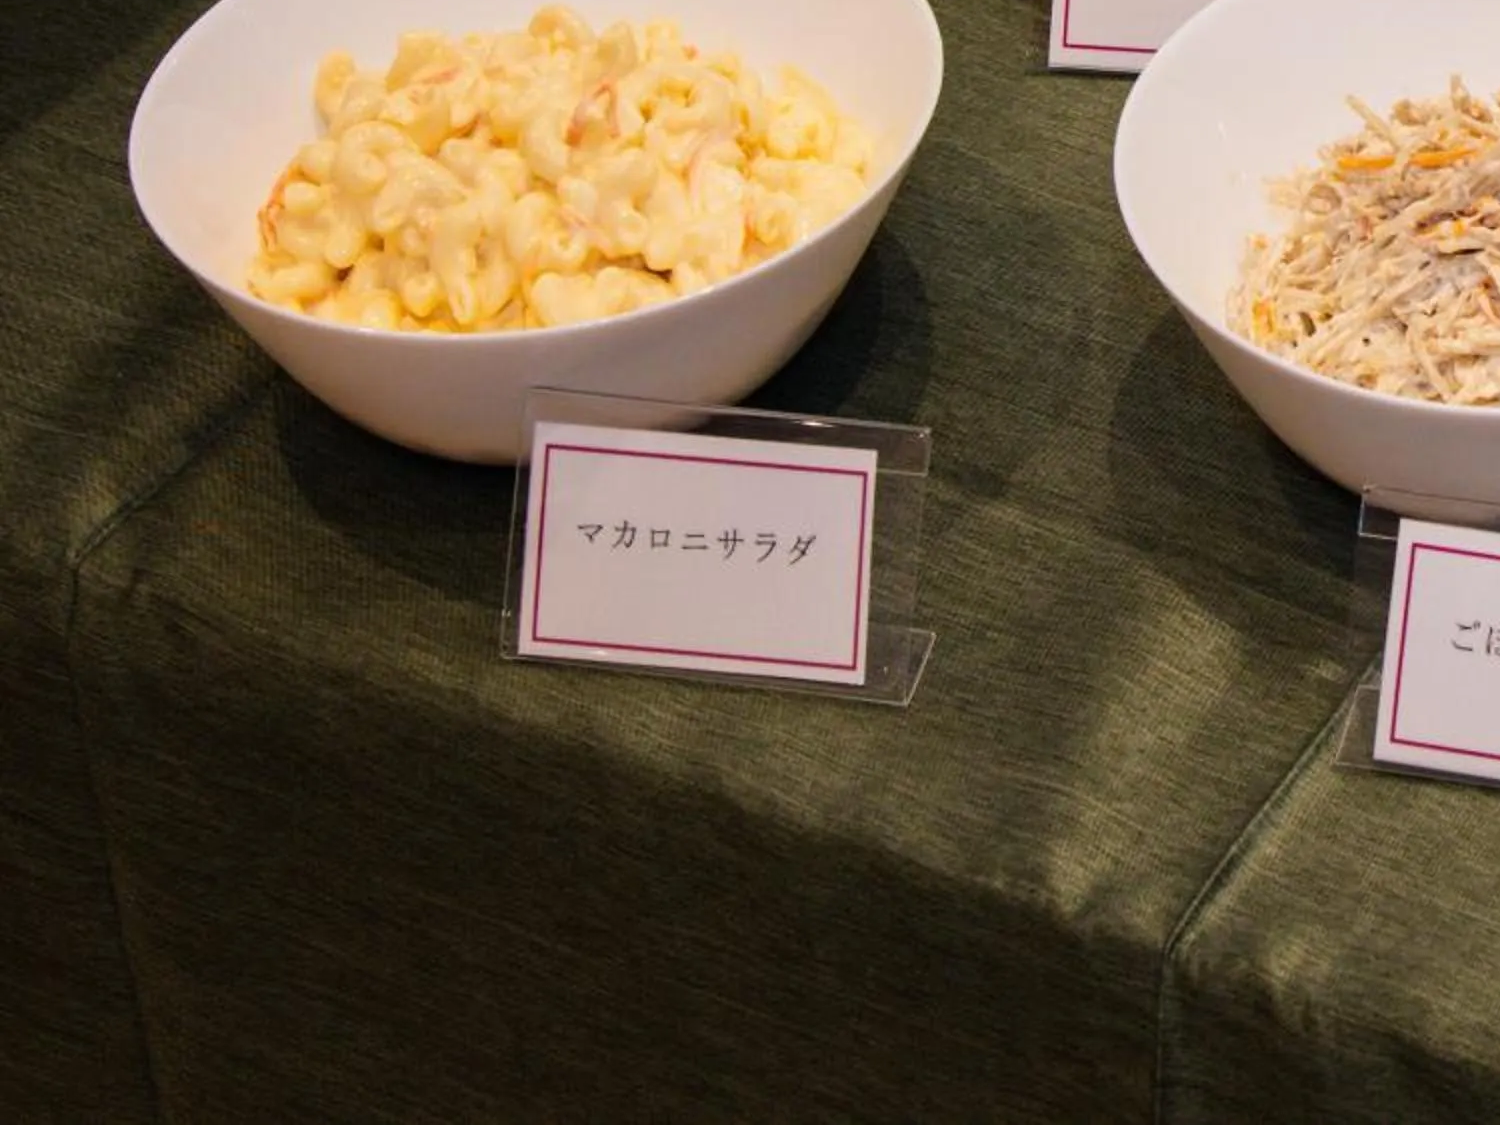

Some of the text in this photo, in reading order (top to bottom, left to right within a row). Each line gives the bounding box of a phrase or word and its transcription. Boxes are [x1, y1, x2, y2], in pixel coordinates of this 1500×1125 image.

[577, 519, 817, 566] マカロニサラダ
